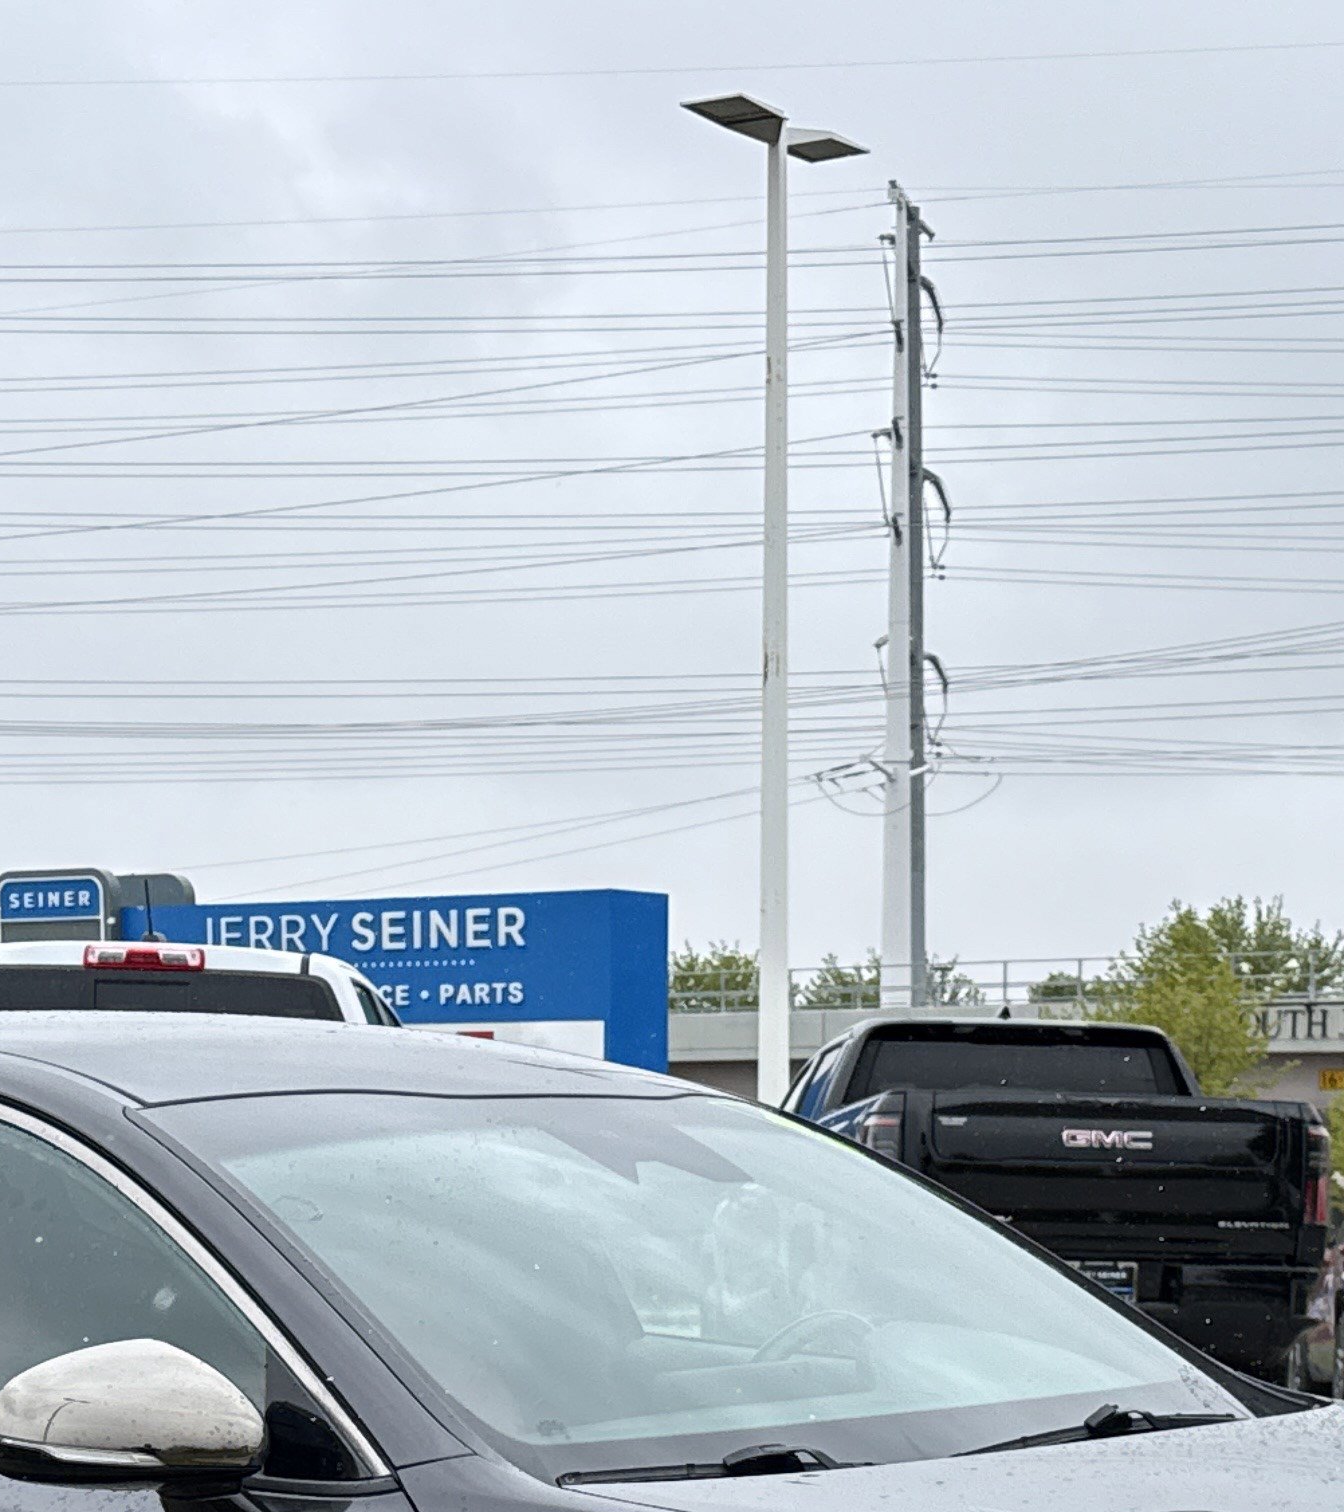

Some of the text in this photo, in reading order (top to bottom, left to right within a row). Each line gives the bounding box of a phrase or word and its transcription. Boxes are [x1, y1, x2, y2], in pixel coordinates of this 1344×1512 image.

[8, 890, 91, 909] SEINER
[351, 906, 526, 951] SEINER
[439, 982, 525, 1006] PARTS
[1062, 1129, 1154, 1150] GMC
